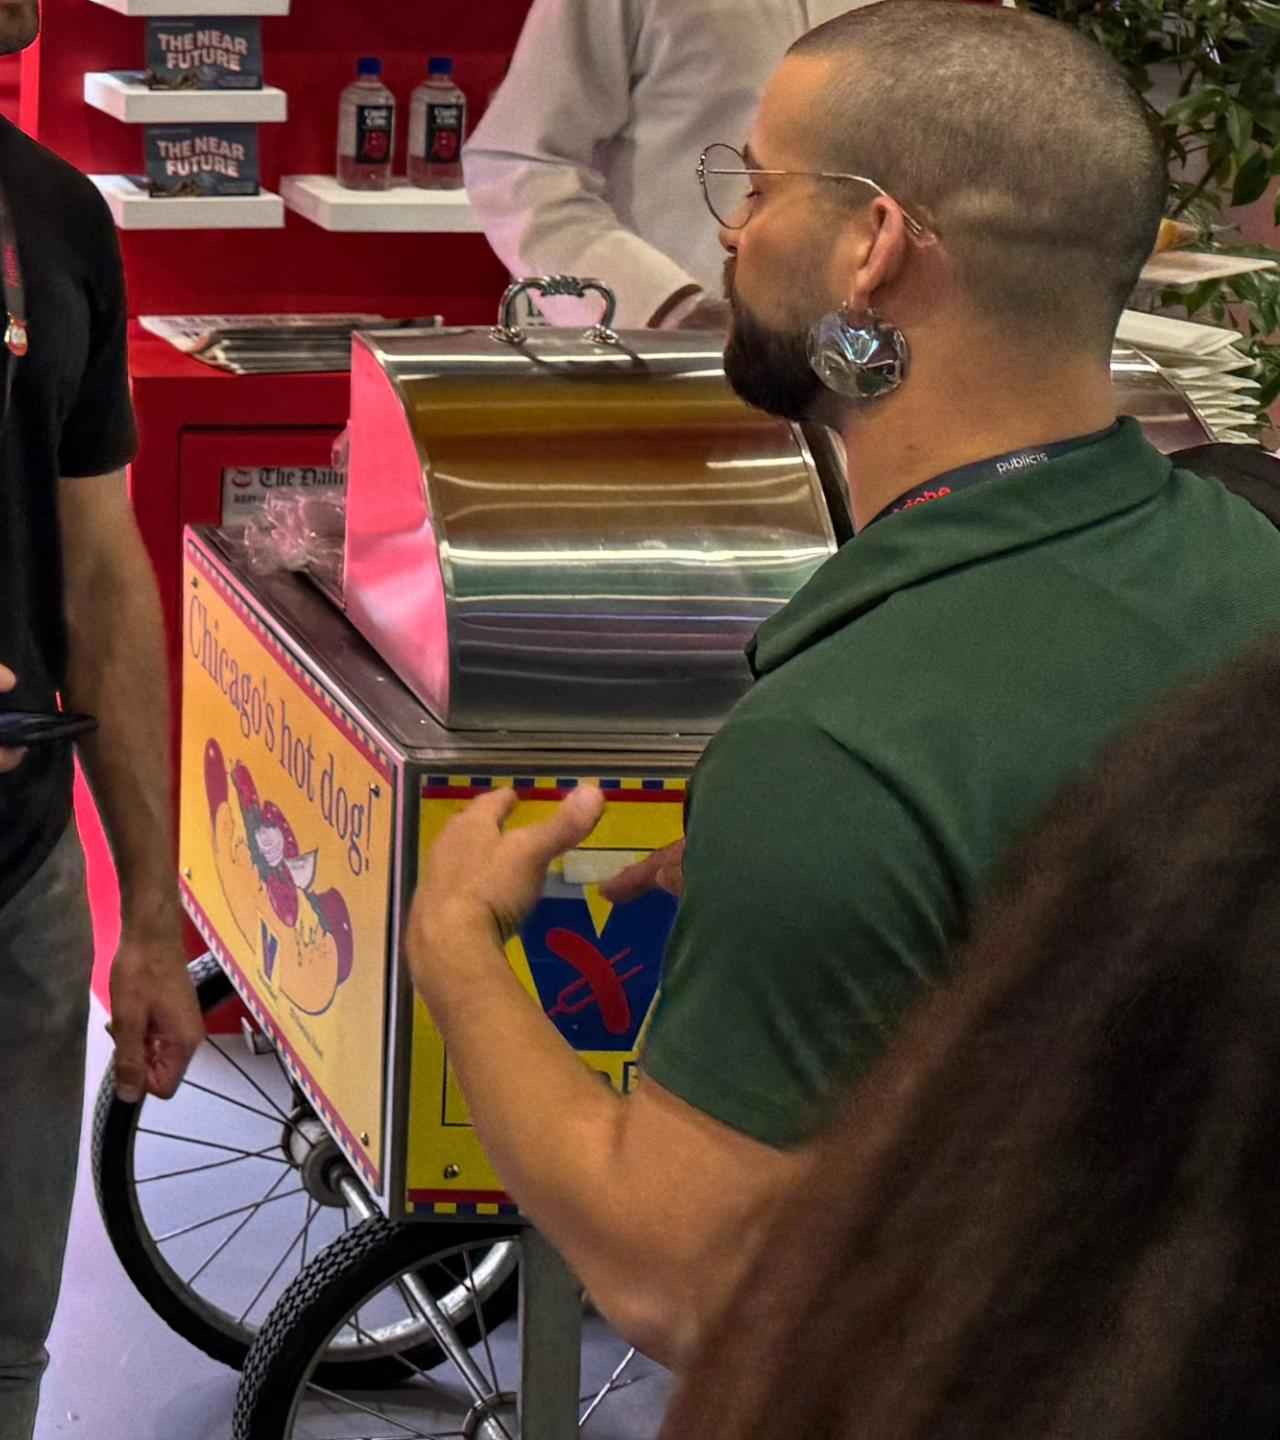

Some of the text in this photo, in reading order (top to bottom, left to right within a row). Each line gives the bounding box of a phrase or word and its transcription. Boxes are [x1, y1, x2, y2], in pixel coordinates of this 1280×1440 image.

[158, 29, 248, 55] THE NEAR
[166, 48, 241, 72] FUTURE
[157, 136, 245, 160] THE NEAR
[165, 154, 240, 178] FUTURE
[996, 451, 1049, 476] publicis
[258, 468, 295, 488] The
[190, 594, 375, 877] Chicago's hot dog!
